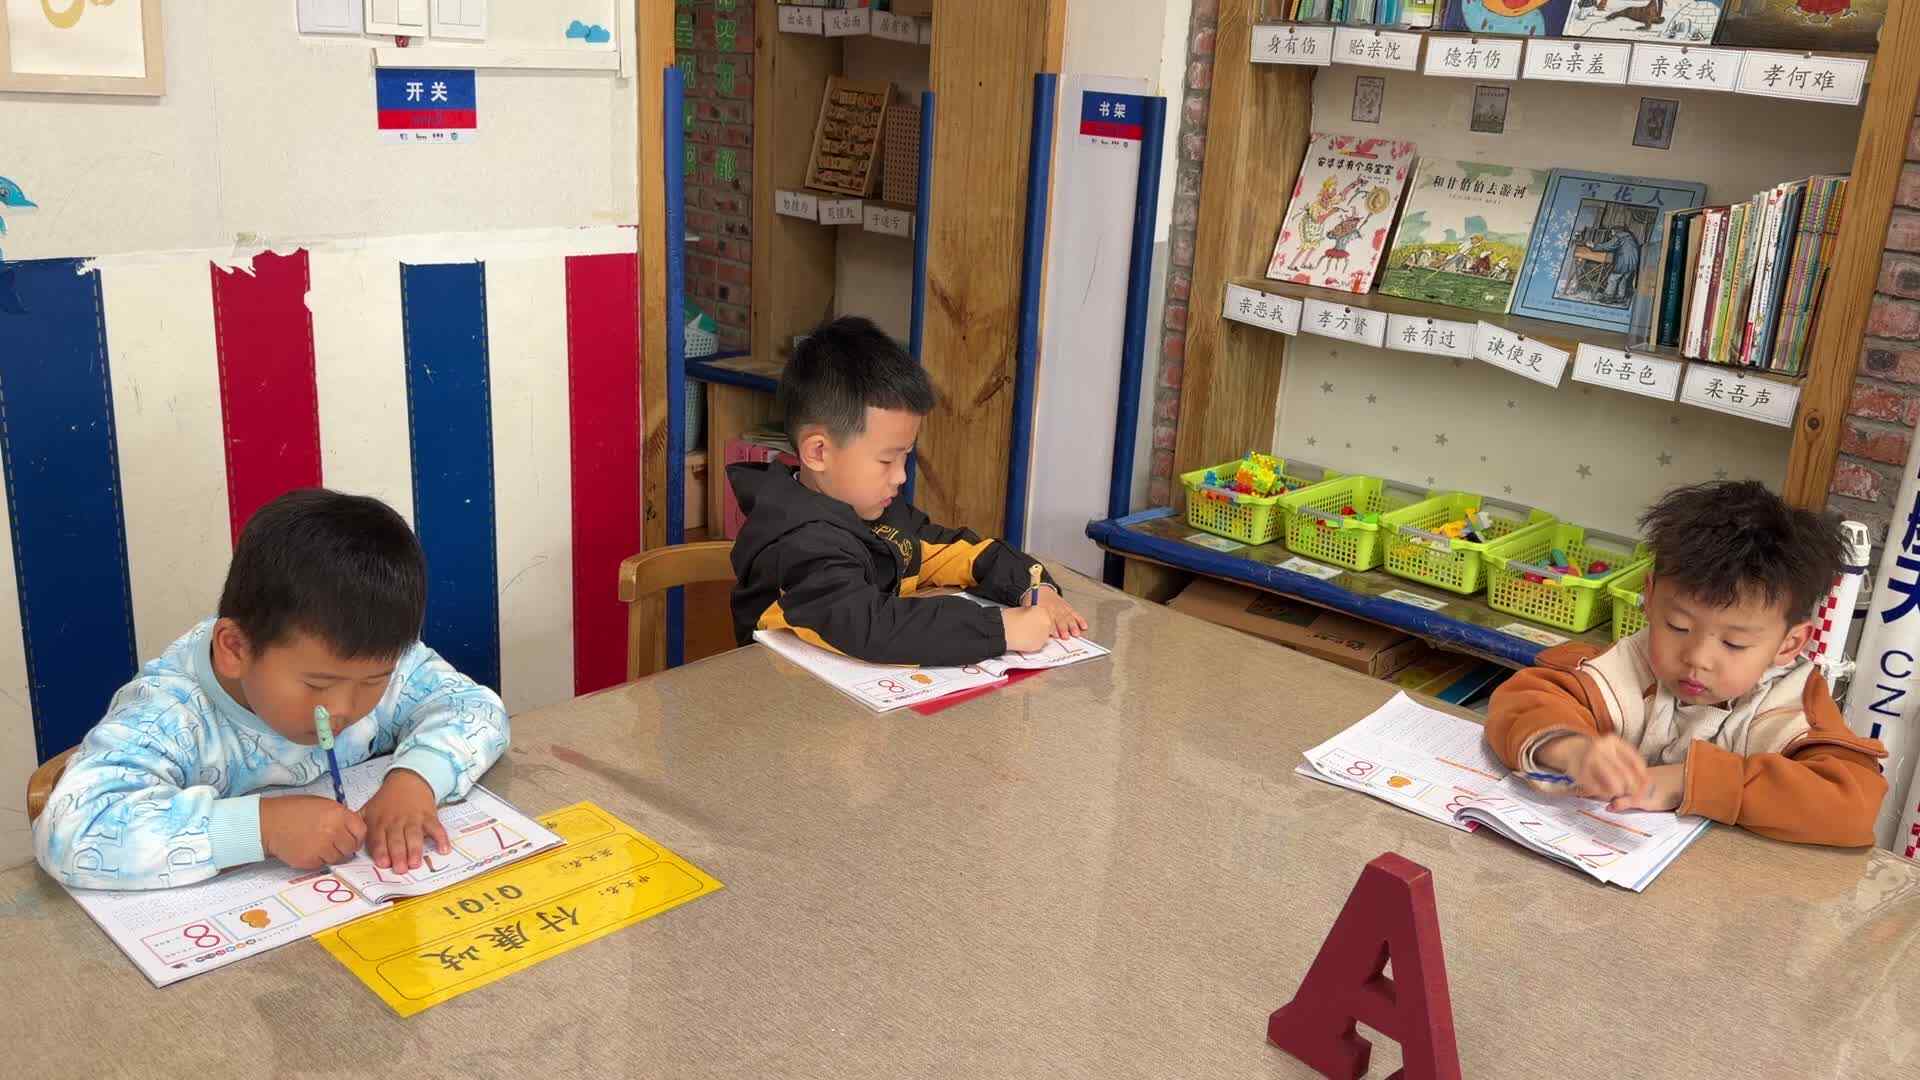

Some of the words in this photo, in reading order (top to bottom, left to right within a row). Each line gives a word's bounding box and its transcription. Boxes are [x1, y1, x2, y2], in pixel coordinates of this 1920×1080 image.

[1268, 33, 1317, 55] 身有伤
[1349, 38, 1401, 61] 贻亲忧
[1443, 47, 1502, 70] 德有伤
[1543, 52, 1606, 75] 贻亲羞
[1650, 56, 1717, 82] 亲爱我
[1763, 63, 1836, 92] 孝何难
[406, 81, 448, 102] 开关
[1098, 100, 1127, 119] 书架
[1239, 296, 1284, 324] 亲恶我
[1318, 309, 1368, 337] 孝方贤
[1402, 324, 1457, 349] 亲有过
[1487, 336, 1543, 373] 谏使更
[1593, 356, 1657, 387] 怡吾色
[1705, 378, 1773, 408] 柔吾声
[877, 679, 905, 694] 8
[1346, 760, 1374, 777] 8
[313, 878, 355, 903] 8
[442, 884, 523, 920] QiQi
[183, 924, 221, 948] 8
[1266, 851, 1465, 1080] A
